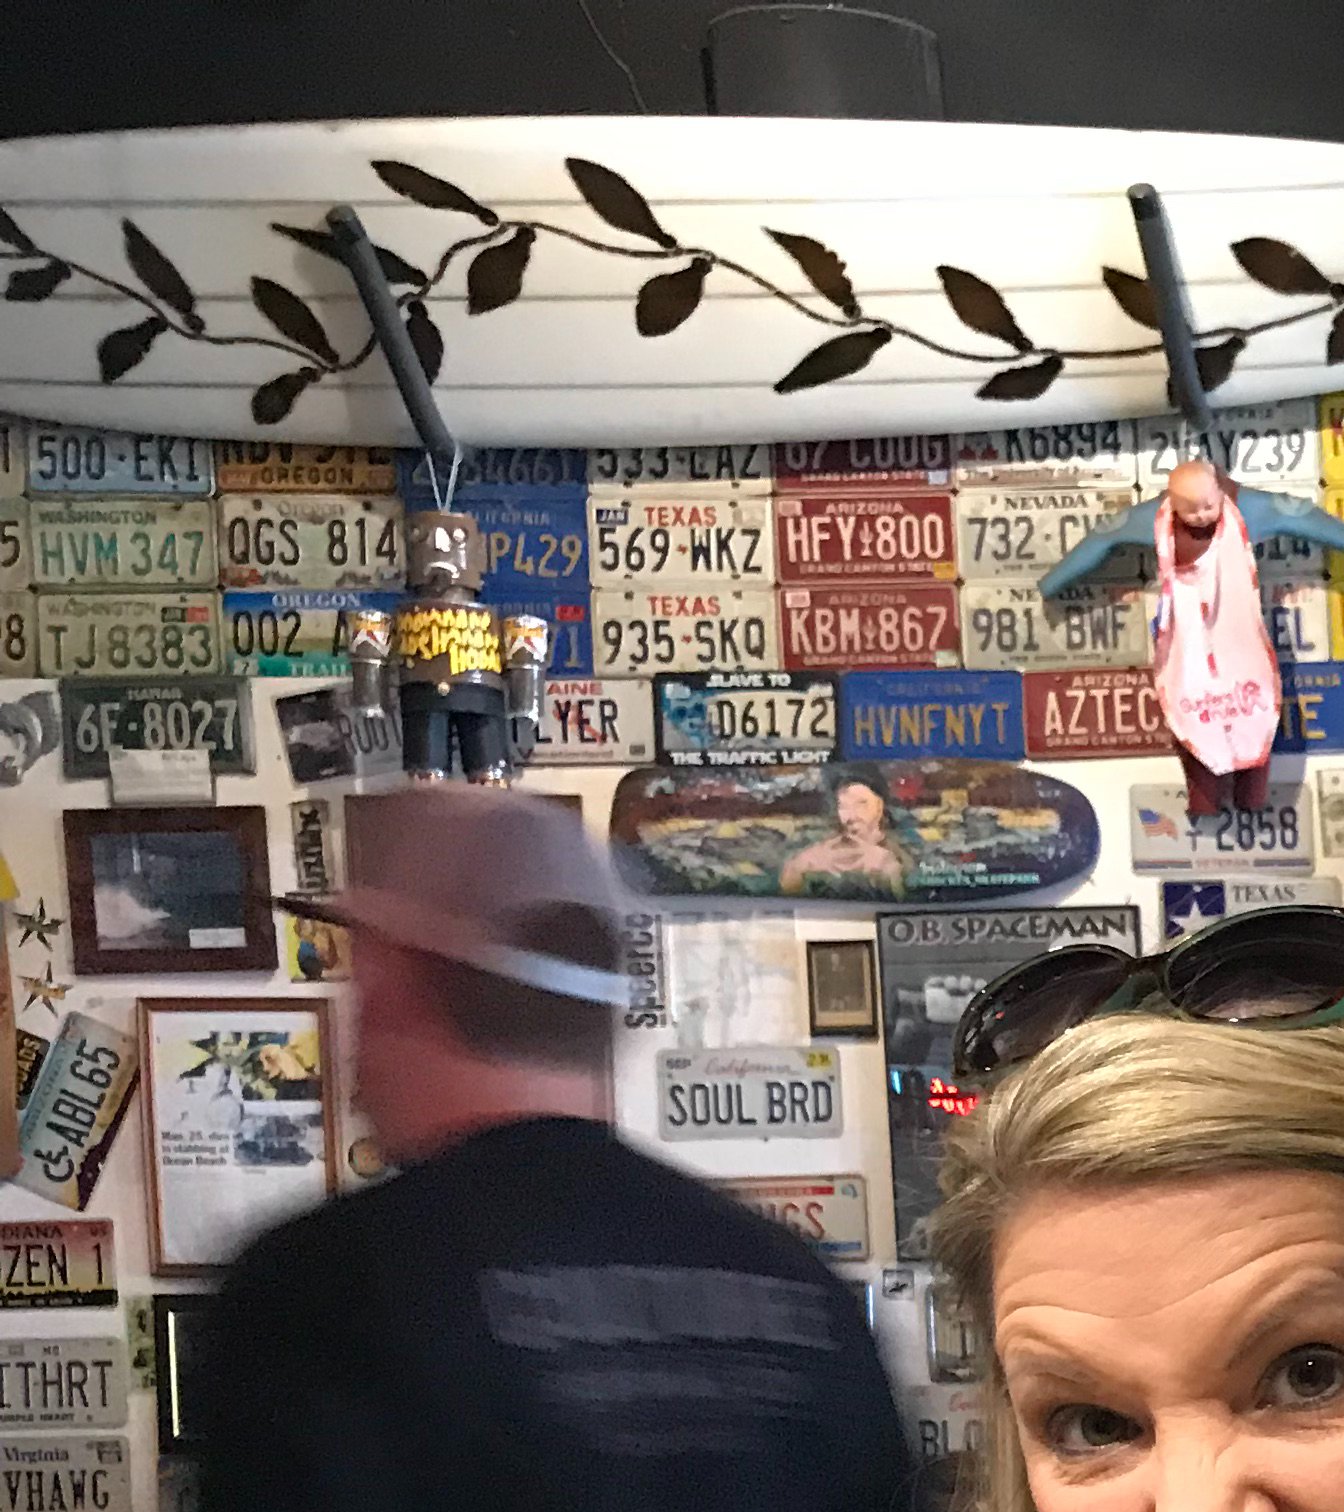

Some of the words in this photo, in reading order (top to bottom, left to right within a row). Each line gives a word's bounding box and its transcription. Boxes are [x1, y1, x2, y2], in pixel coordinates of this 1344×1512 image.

[644, 506, 718, 528] TEXAS
[966, 517, 1036, 563] 732
[129, 530, 204, 577] 347
[326, 516, 399, 567] 814
[598, 527, 671, 575] 569
[646, 595, 722, 617] TEXAS
[602, 617, 677, 667] 935
[972, 607, 1041, 653] 981
[667, 1083, 758, 1128] SOUL
[766, 1080, 834, 1125] BRD
